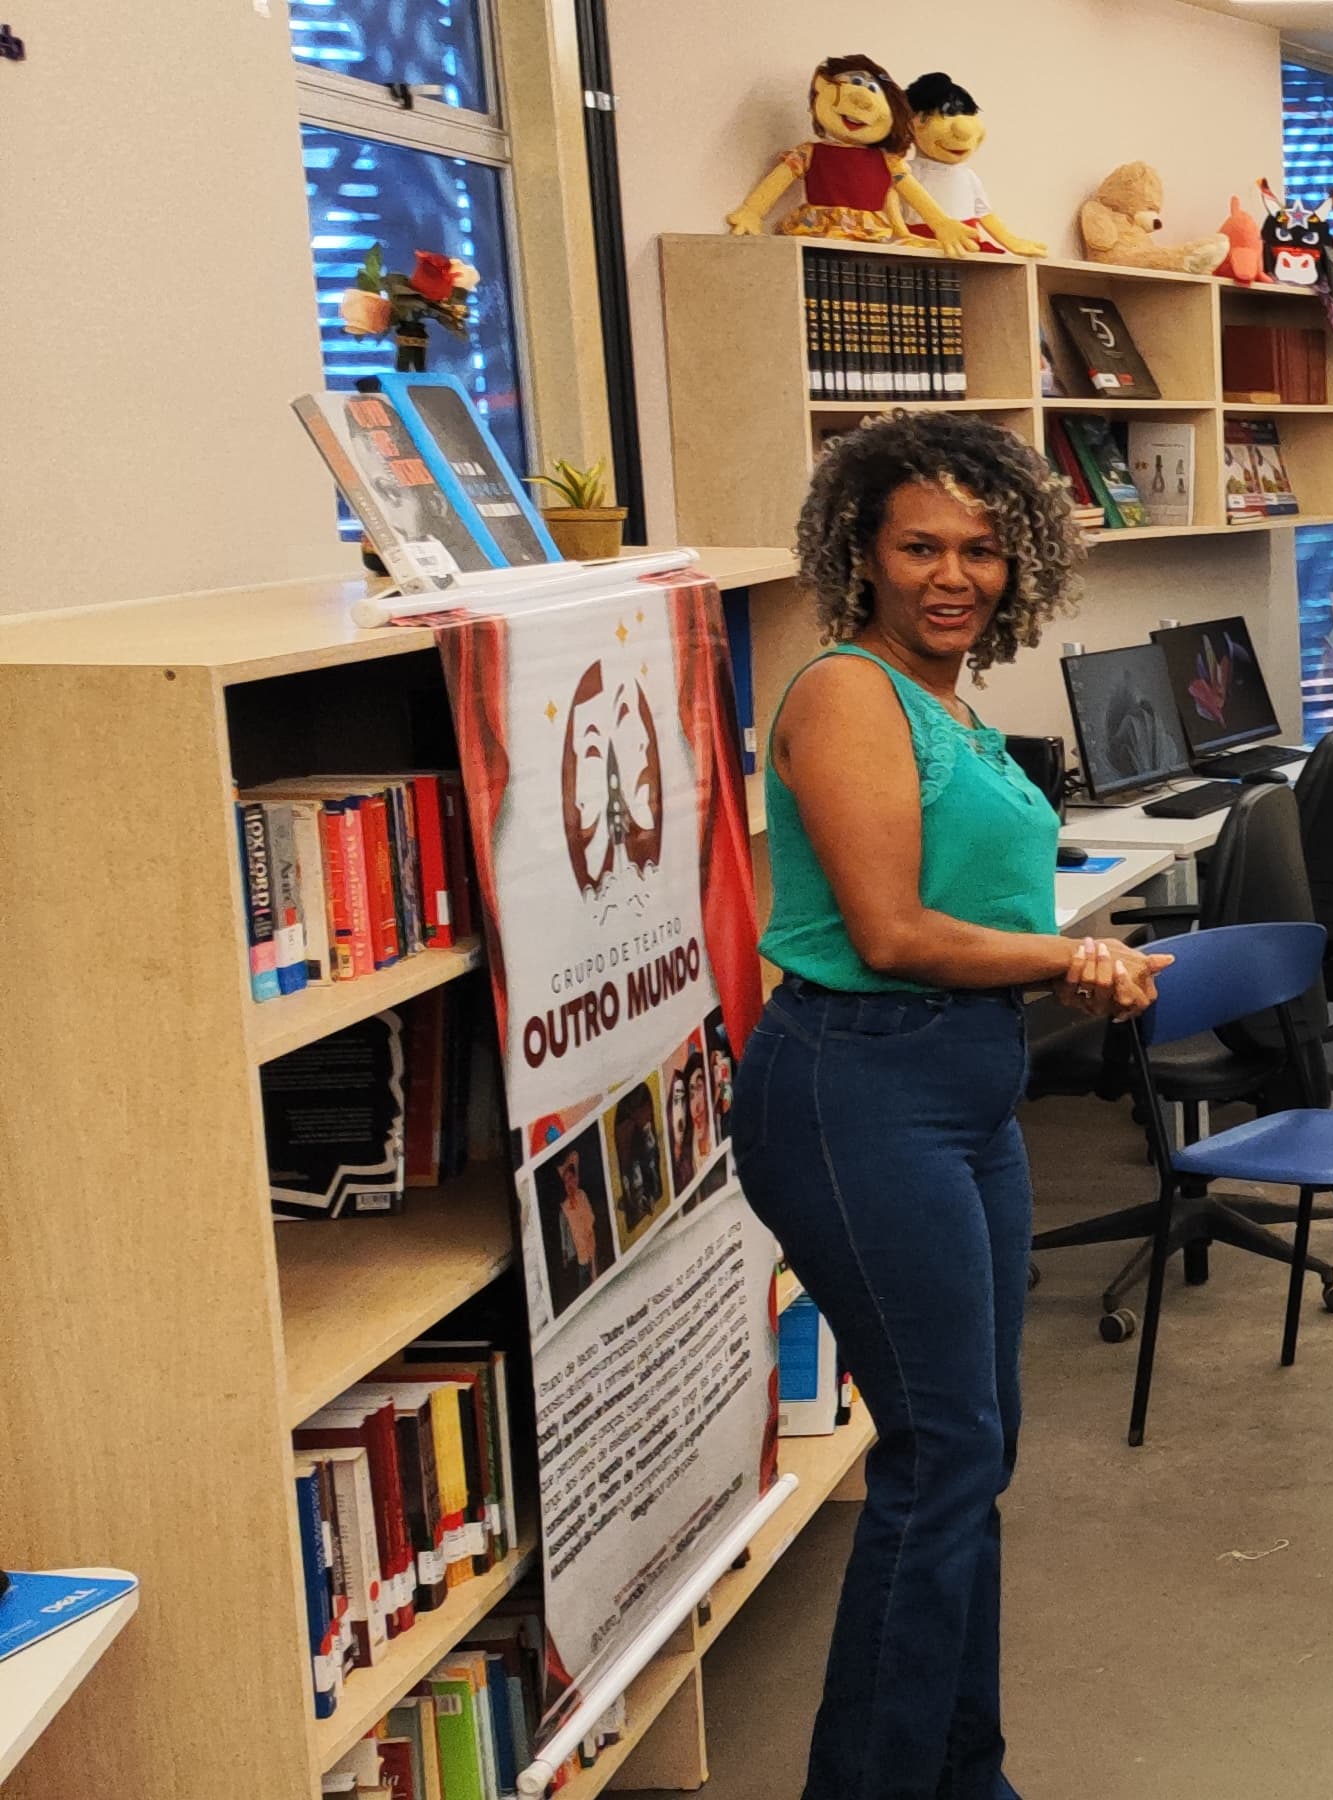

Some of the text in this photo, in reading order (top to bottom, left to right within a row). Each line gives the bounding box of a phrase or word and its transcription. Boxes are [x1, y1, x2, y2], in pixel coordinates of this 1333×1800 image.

[551, 917, 682, 993] GRUPO DE TEATRO
[523, 937, 700, 1068] OUTRO MUNDO
[40, 1588, 98, 1613] DELL
